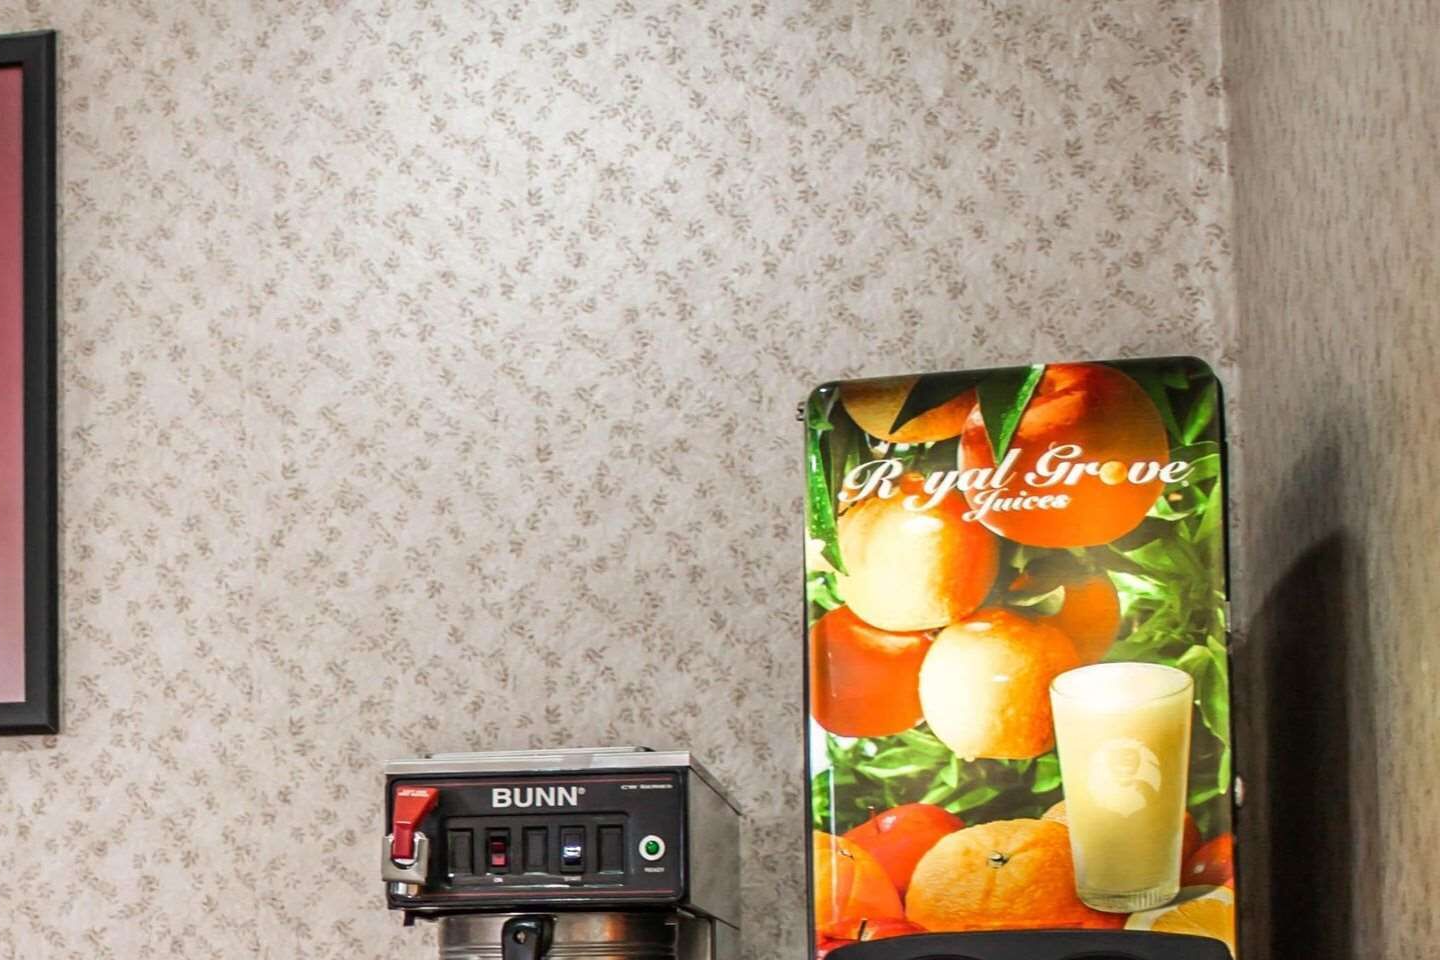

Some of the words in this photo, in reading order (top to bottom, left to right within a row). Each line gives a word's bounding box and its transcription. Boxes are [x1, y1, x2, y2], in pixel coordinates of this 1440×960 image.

[1024, 442, 1192, 487] Grove
[962, 487, 1071, 522] Juices
[491, 786, 578, 808] BUNN
